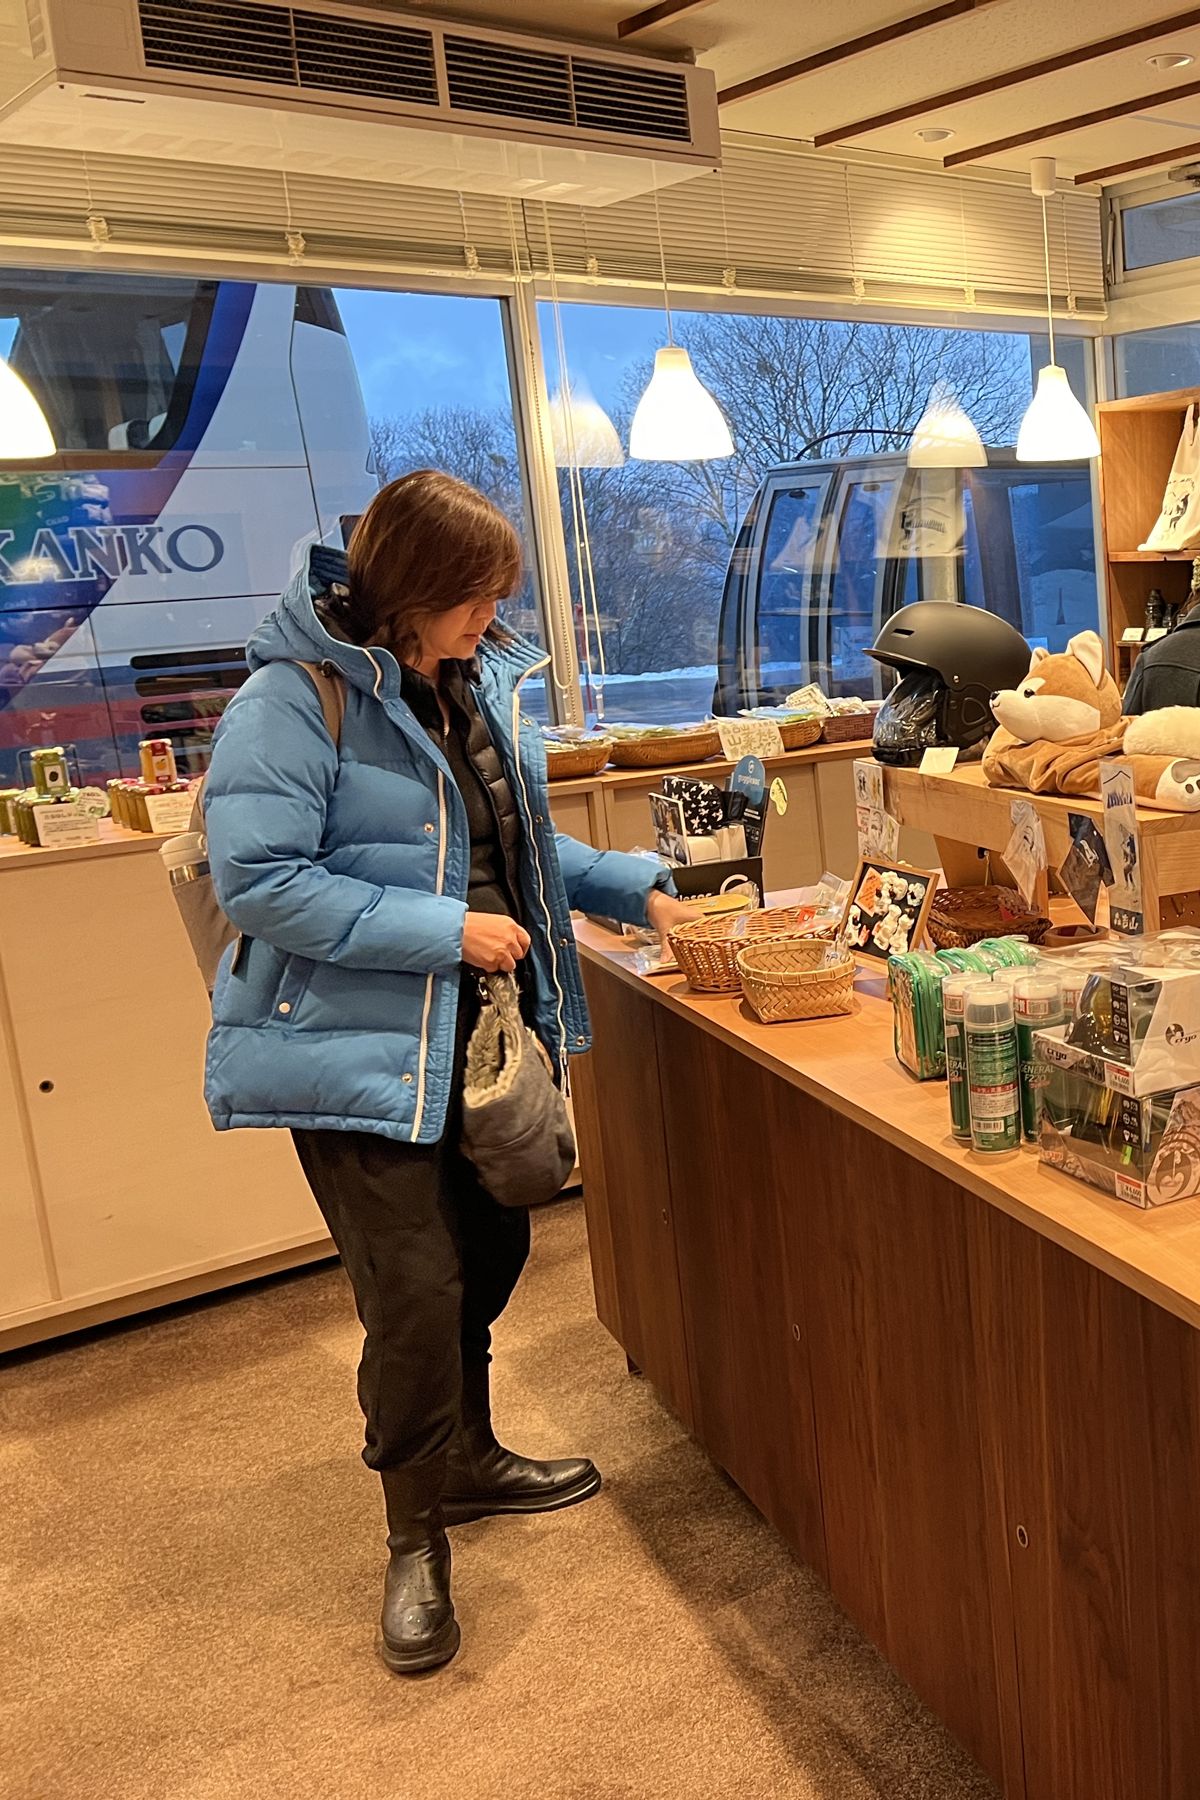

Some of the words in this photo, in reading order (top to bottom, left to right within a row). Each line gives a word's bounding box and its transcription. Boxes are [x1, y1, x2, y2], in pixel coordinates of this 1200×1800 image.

[1175, 1034, 1198, 1044] cryo
[1046, 1048, 1068, 1061] cryo
[1020, 1062, 1055, 1074] GENERAL
